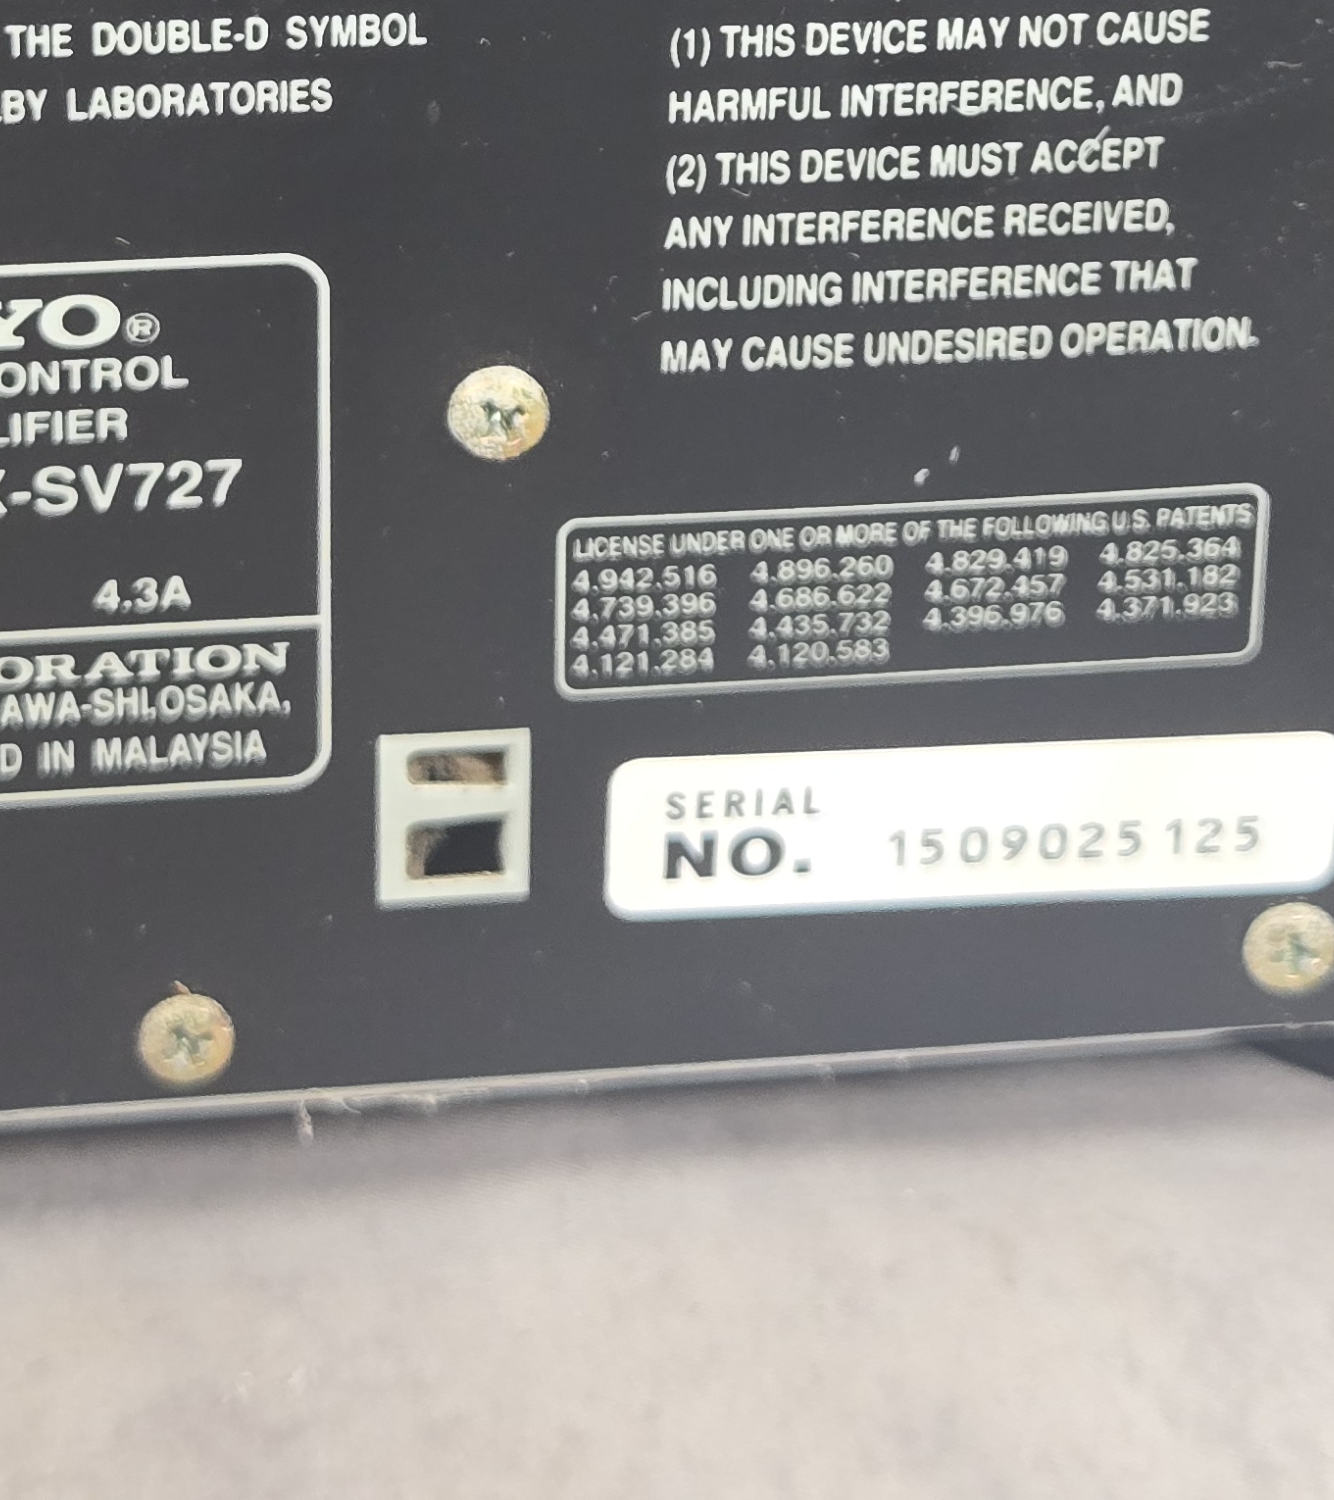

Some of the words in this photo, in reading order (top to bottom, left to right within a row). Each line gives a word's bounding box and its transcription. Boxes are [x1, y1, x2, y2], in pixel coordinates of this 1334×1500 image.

[4, 24, 73, 58] THE
[92, 16, 268, 56] DOUBLE-D
[286, 12, 427, 50] SYMBOL
[670, 27, 710, 68] (1)
[720, 24, 795, 58] THIS
[806, 19, 927, 58] DEVICE
[937, 17, 1010, 50] MAY
[1019, 13, 1089, 48] NOT
[1097, 8, 1210, 46] CAUSE
[67, 78, 332, 121] LABORATORIES
[669, 86, 831, 123] HARMFUL
[841, 76, 1104, 118] INTERFERENCE,
[1112, 73, 1183, 107] AND
[666, 154, 706, 194] (2)
[715, 150, 790, 185] THIS
[800, 146, 920, 183] DEVICE
[930, 142, 1023, 178] MUST
[1030, 135, 1165, 173] ACCEPT
[664, 216, 733, 249] ANY
[743, 205, 994, 246] INTERFERENCE
[1004, 198, 1175, 236] RECEIVED,
[662, 272, 842, 311] INCLUDING
[852, 262, 1102, 304] INTERFERENCE
[1110, 257, 1198, 292] THAT
[661, 338, 733, 373] MAY
[742, 333, 854, 371] CAUSE
[864, 325, 1053, 366] UNDESIRED
[573, 534, 664, 562] LICENSE
[670, 530, 745, 557] UNDER
[749, 527, 794, 553] ONE
[799, 526, 832, 550] OR
[835, 522, 897, 547] MORE
[902, 520, 931, 545] OF
[937, 518, 977, 542] THE
[1157, 503, 1255, 532] PATENTS
[93, 575, 191, 612] 4.3A
[39, 740, 74, 773] IN
[92, 730, 266, 771] MALAYSIA
[666, 788, 819, 820] SERIAL
[664, 827, 812, 881] NO.
